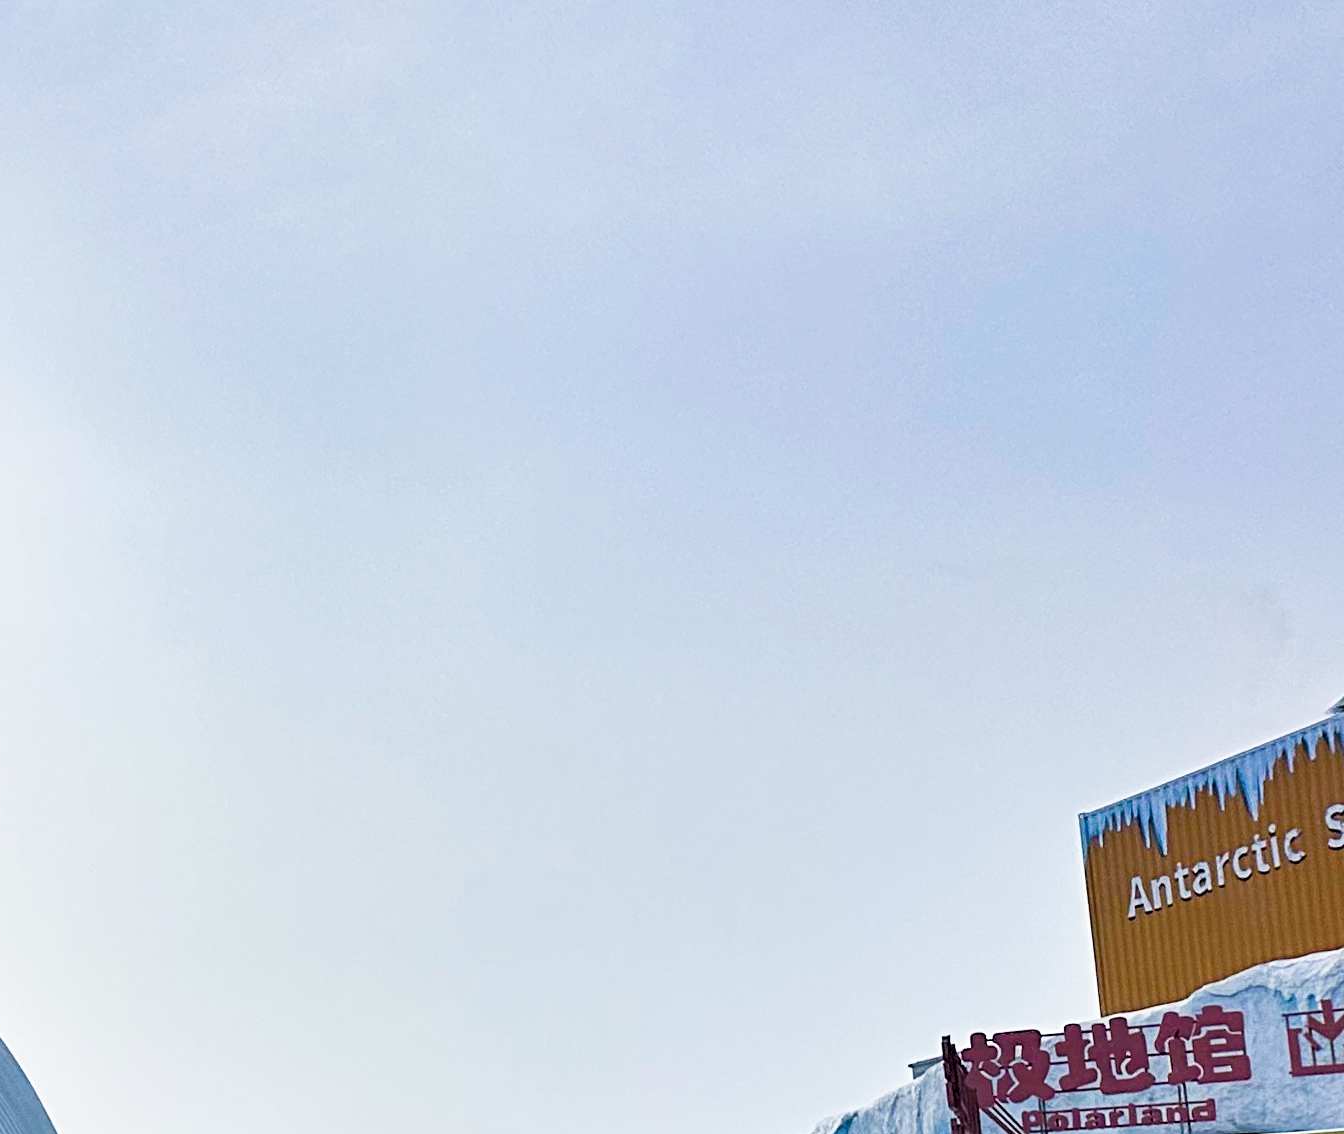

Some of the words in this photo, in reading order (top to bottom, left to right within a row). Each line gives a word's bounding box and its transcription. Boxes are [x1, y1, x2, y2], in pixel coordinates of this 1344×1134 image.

[1127, 823, 1307, 920] Antarctic
[961, 1004, 1252, 1109] 极地馆
